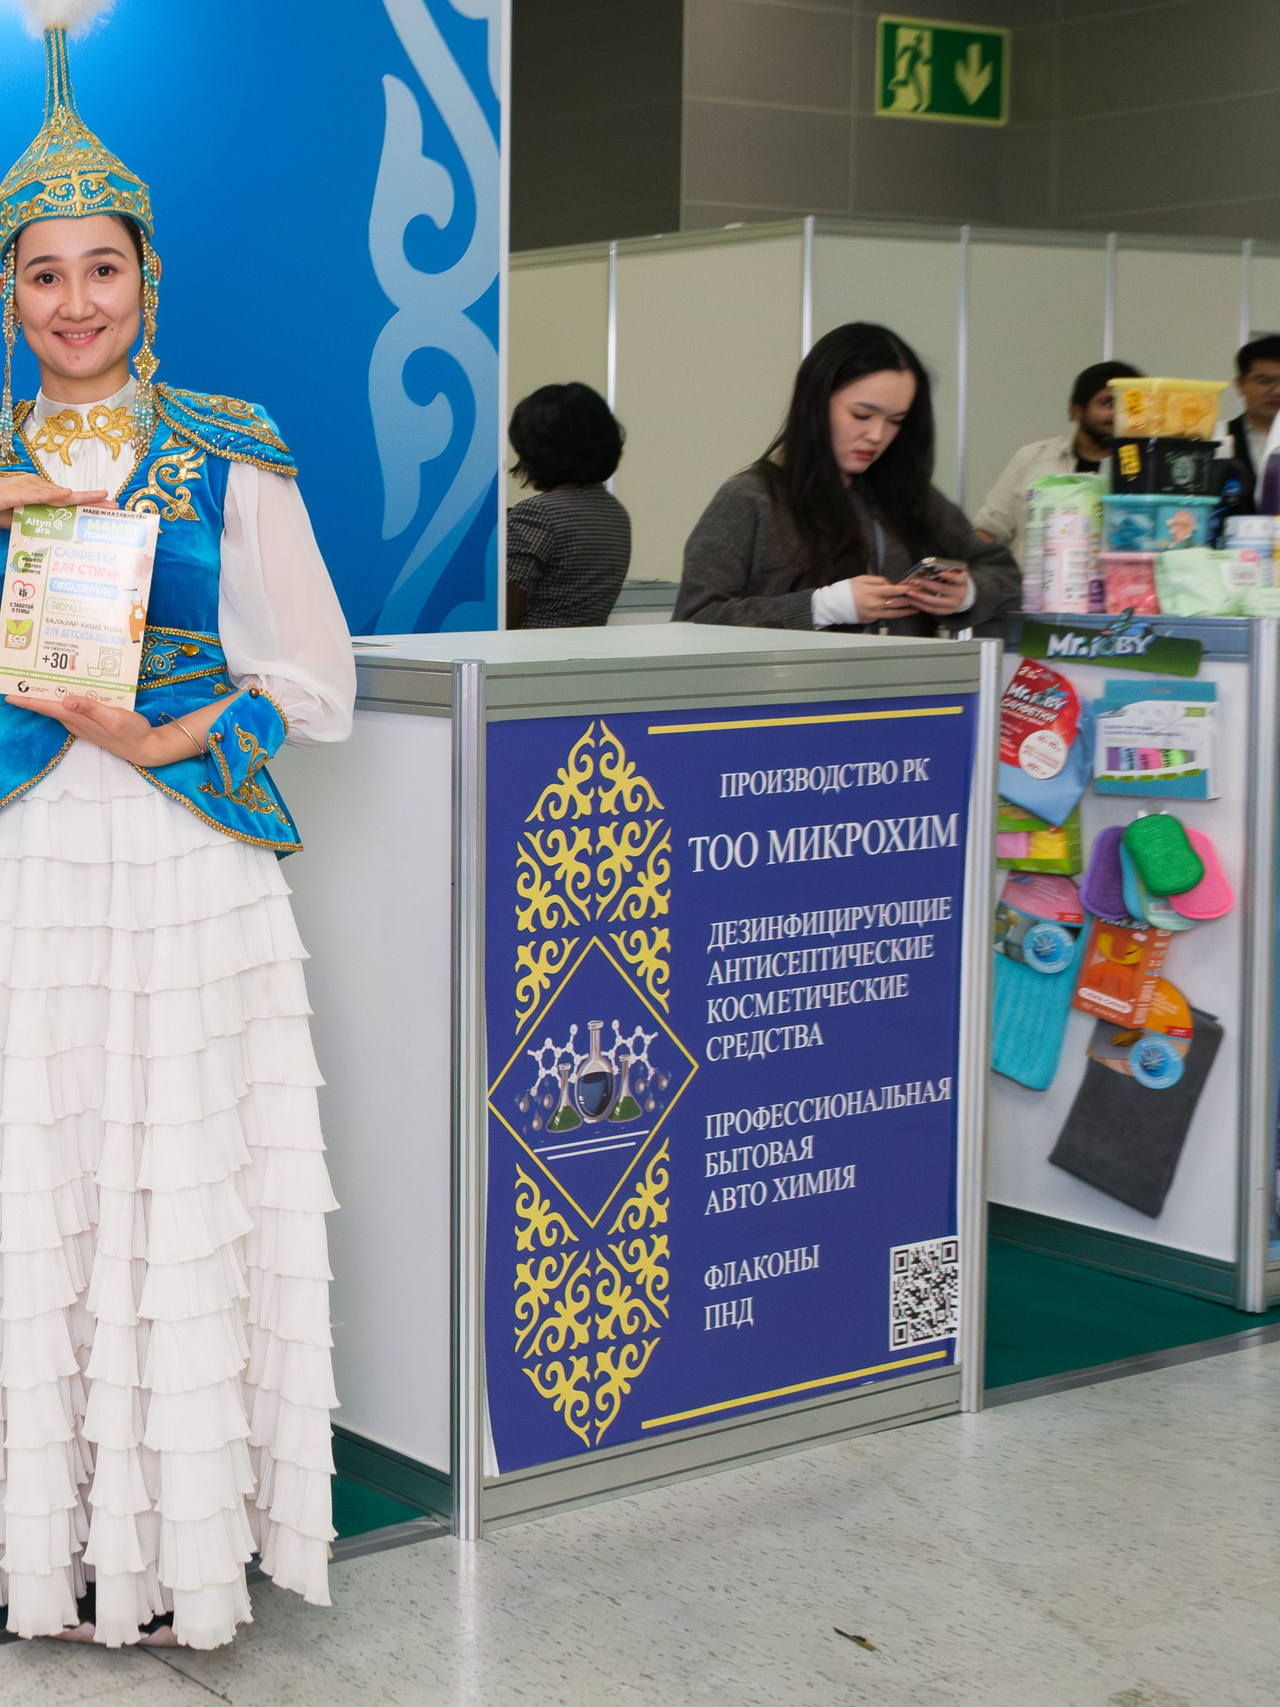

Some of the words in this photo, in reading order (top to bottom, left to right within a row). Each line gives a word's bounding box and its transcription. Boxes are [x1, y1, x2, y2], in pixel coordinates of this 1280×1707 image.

[25, 518, 51, 529] Altyn
[35, 527, 50, 535] ara
[82, 508, 99, 516] MADE
[107, 512, 147, 520] KAZAKHSTAN
[51, 561, 75, 574] ДЛЯ
[78, 564, 120, 579] СТИРКИ
[54, 546, 116, 565] САЛФЕТКИ
[8, 635, 27, 643] ECO
[44, 626, 59, 636] ДЛЯ
[60, 628, 94, 640] ДЕТСКОЙ
[46, 618, 78, 627] БАЛАЛАР
[42, 652, 68, 670] +30
[719, 759, 899, 799] ПРОИЗВОДСТВО
[901, 757, 931, 784] РК
[687, 831, 759, 873] ТОО
[766, 812, 960, 865] МИКРОХИМ
[706, 896, 953, 954] ДЕЗИНФИЦИРУЮЩИЕ
[706, 934, 935, 986] АНТИСЕПТИЧЕСКИЕ
[706, 973, 911, 1024] КОСМЕТИЧЕСКИЕ
[705, 1022, 825, 1062] СРЕДСТВА
[704, 1076, 953, 1140] ПРОФЕССИОНАЛЬНАЯ
[704, 1135, 815, 1178] БЫТОВАЯ
[703, 1181, 768, 1216] АВТО
[771, 1164, 857, 1203] ХИМИЯ
[703, 1244, 821, 1290] ФЛАКОНЫ
[703, 1297, 755, 1331] ПНД
